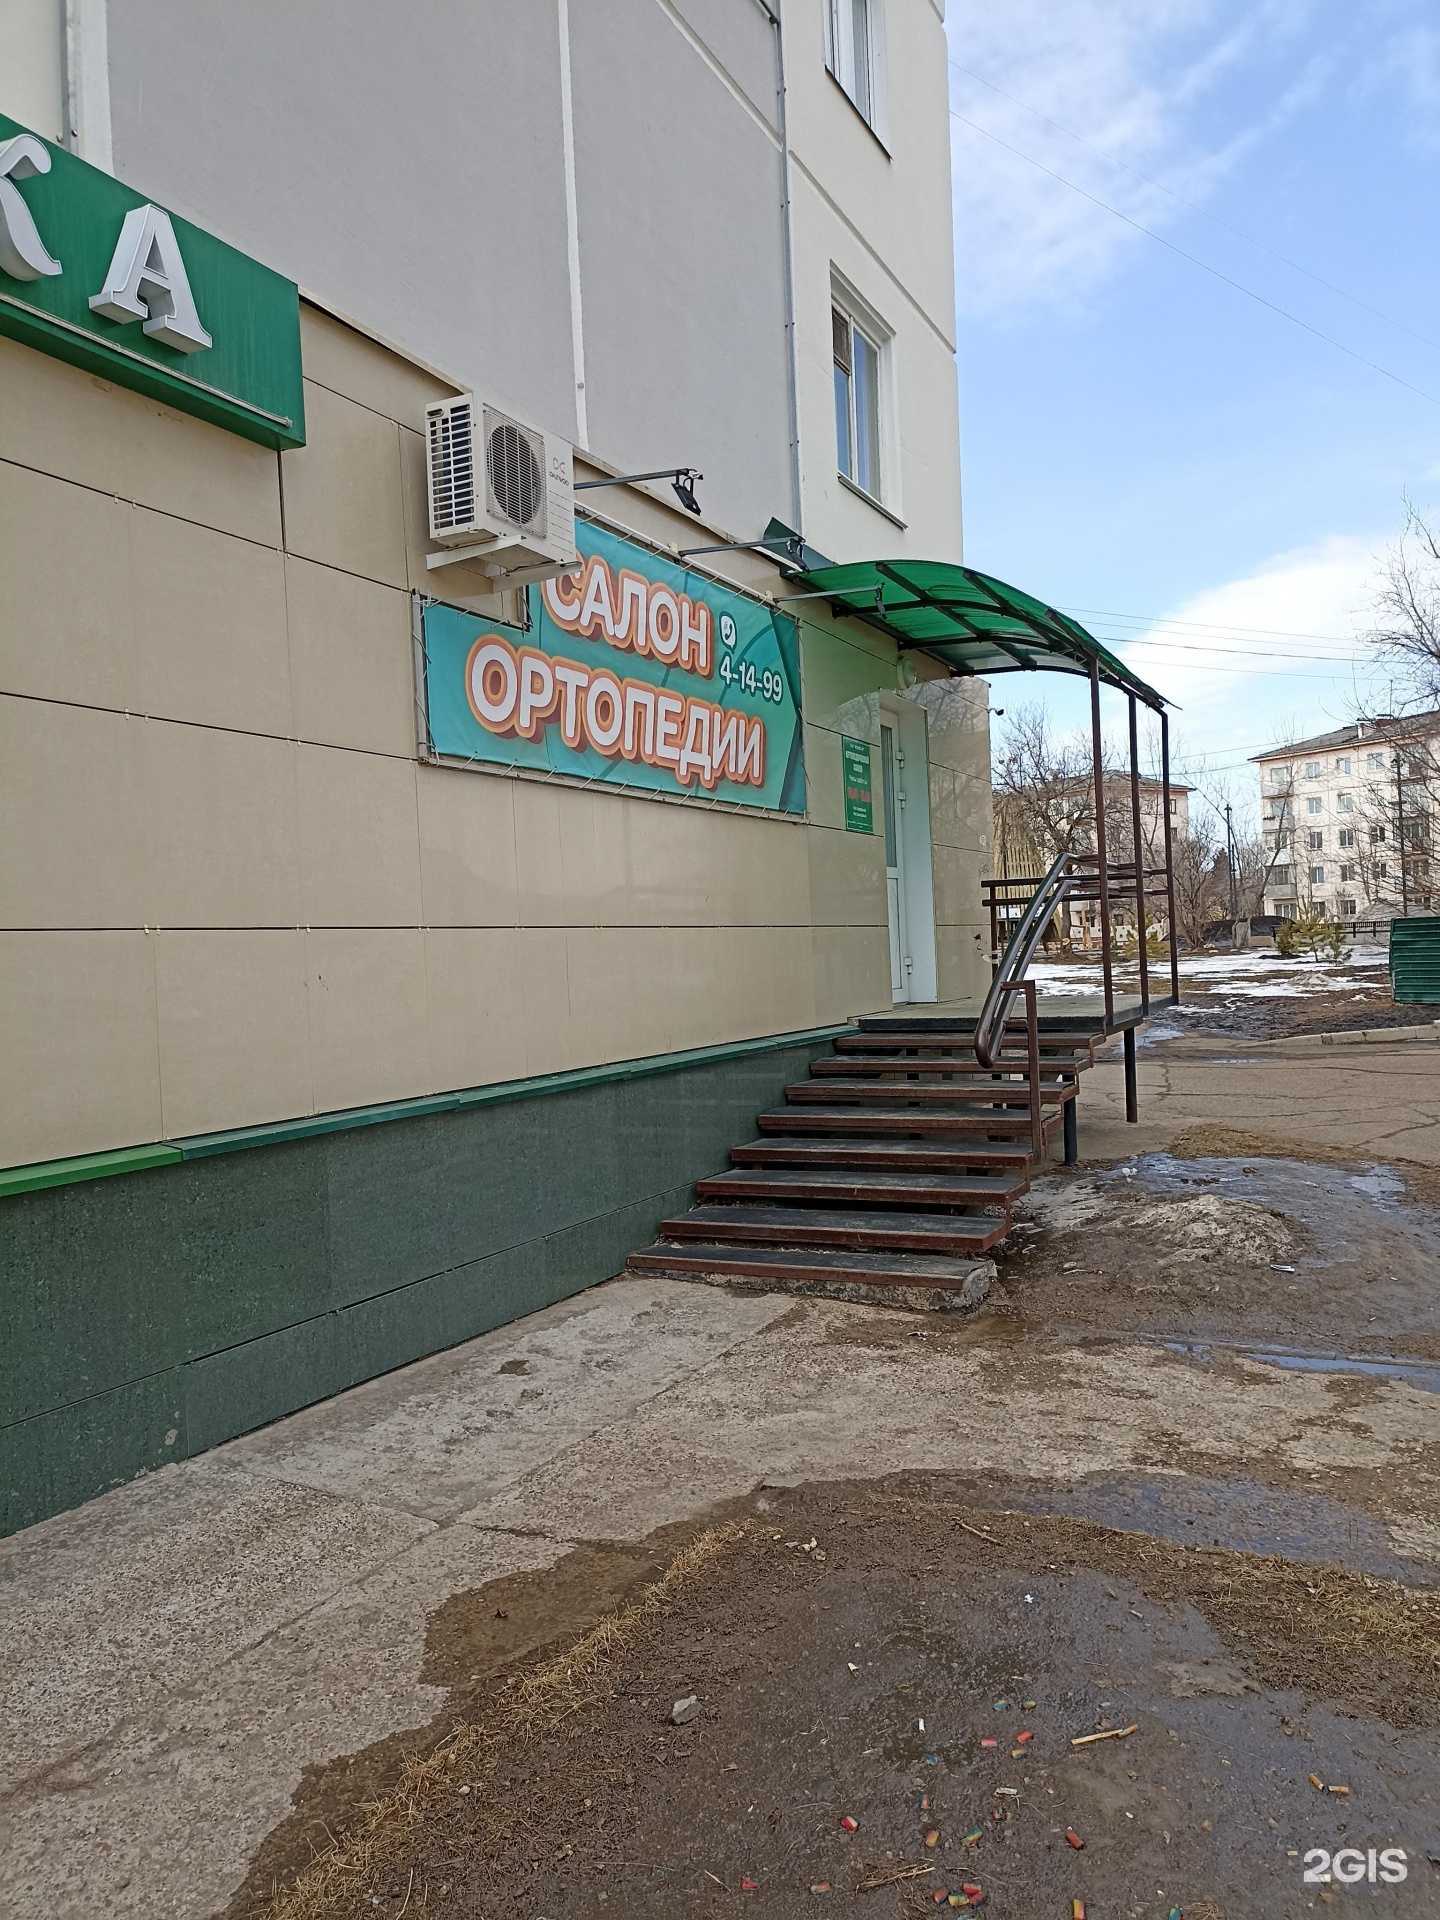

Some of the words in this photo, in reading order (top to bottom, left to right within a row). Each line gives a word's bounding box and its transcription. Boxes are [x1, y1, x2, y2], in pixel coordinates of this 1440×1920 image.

[543, 558, 709, 671] САЛОН
[469, 641, 764, 784] ОРТОПЕДИИ
[719, 653, 784, 704] 4-14-99
